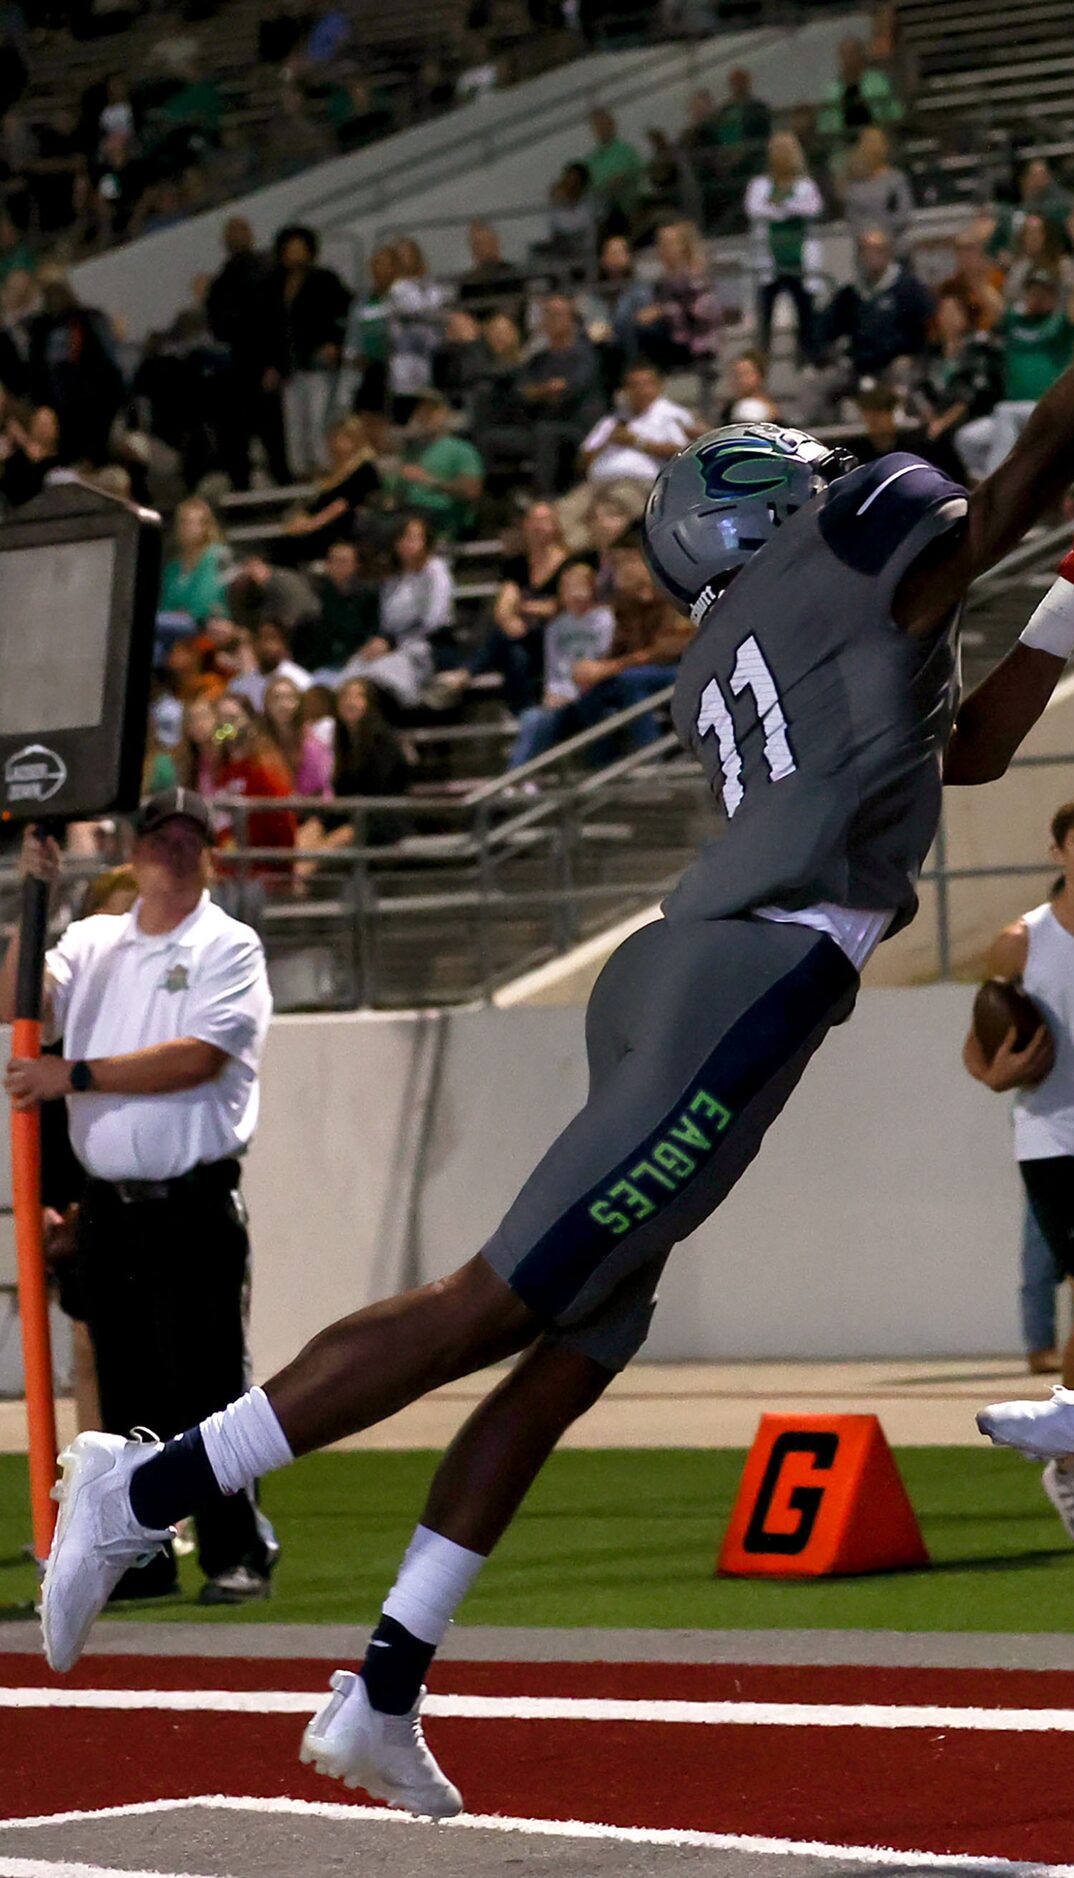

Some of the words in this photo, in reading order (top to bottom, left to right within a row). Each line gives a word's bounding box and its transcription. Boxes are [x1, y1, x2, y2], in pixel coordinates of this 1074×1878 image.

[697, 635, 797, 819] 11
[589, 1089, 732, 1234] EAGLES
[743, 1431, 840, 1555] G
